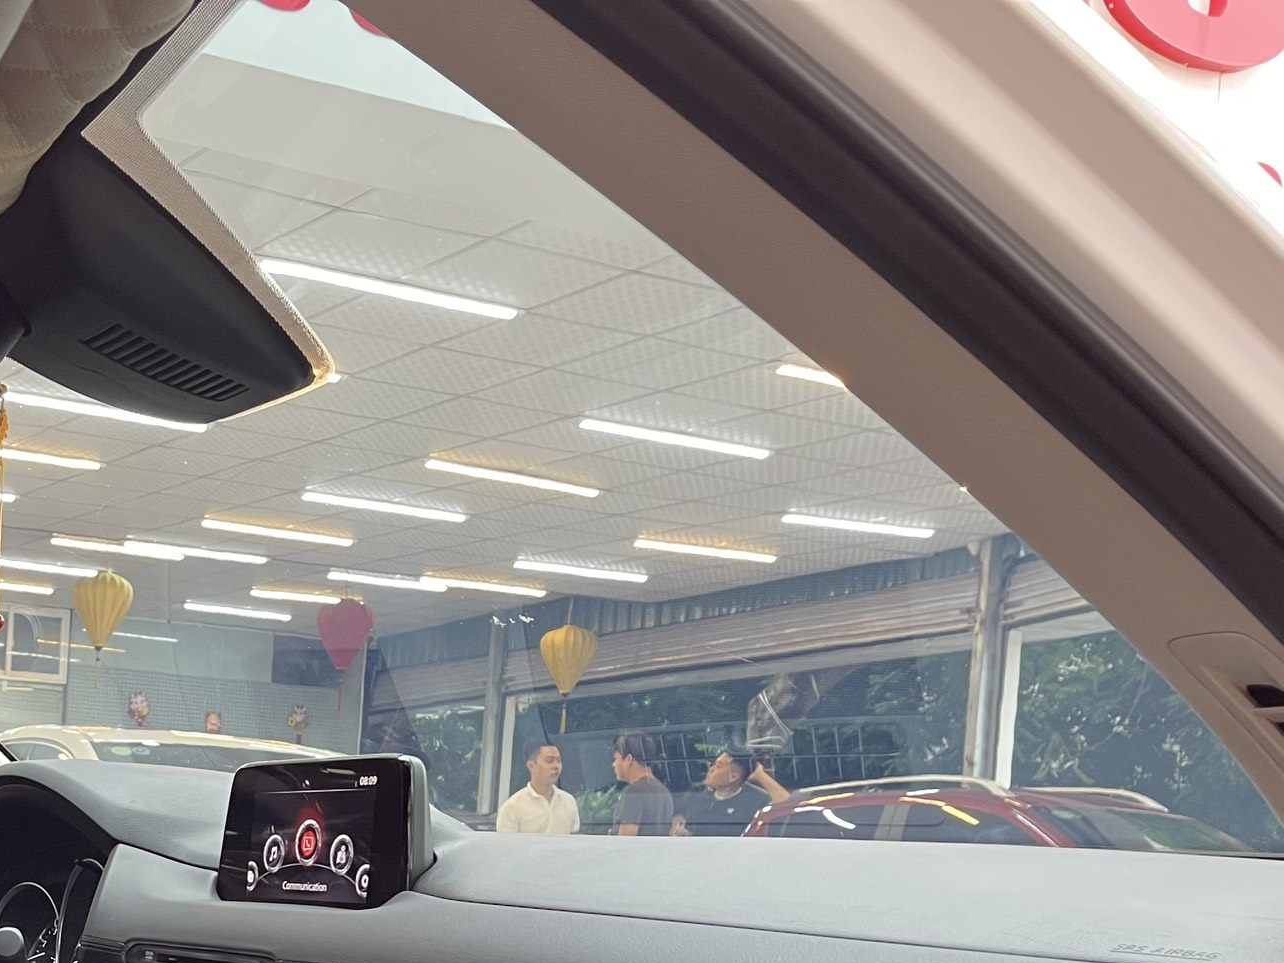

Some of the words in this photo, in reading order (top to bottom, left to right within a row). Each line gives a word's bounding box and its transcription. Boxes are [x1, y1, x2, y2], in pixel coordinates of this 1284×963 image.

[359, 775, 378, 786] 08:09
[281, 880, 328, 892] Communication
[1152, 946, 1223, 960] AIRBAG
